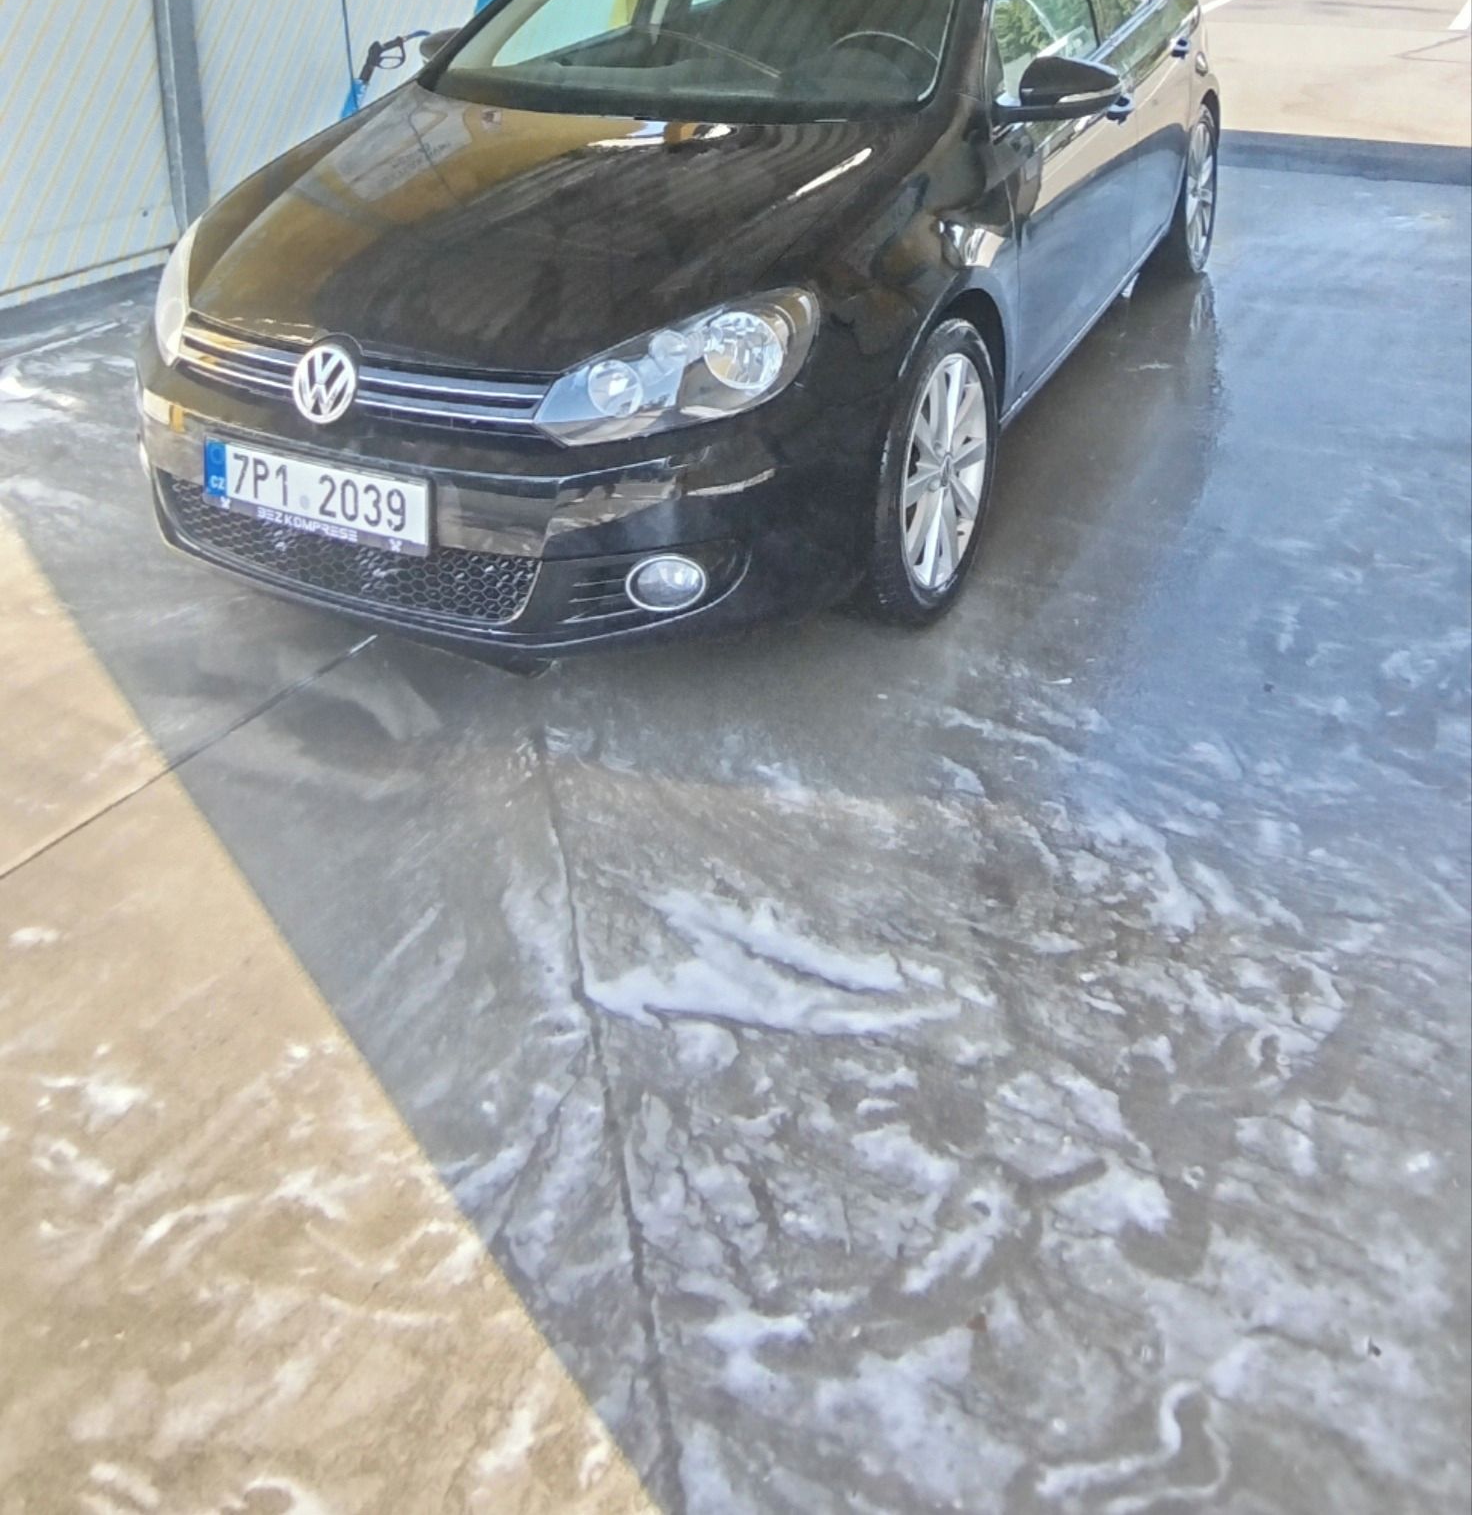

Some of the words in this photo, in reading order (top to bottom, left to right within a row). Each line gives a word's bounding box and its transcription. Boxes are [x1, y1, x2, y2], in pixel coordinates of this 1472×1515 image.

[210, 475, 226, 491] CZ
[233, 452, 288, 507] 7P1
[318, 474, 407, 533] 2039
[257, 506, 283, 524] BEZ
[284, 513, 359, 544] KOMPRESE
